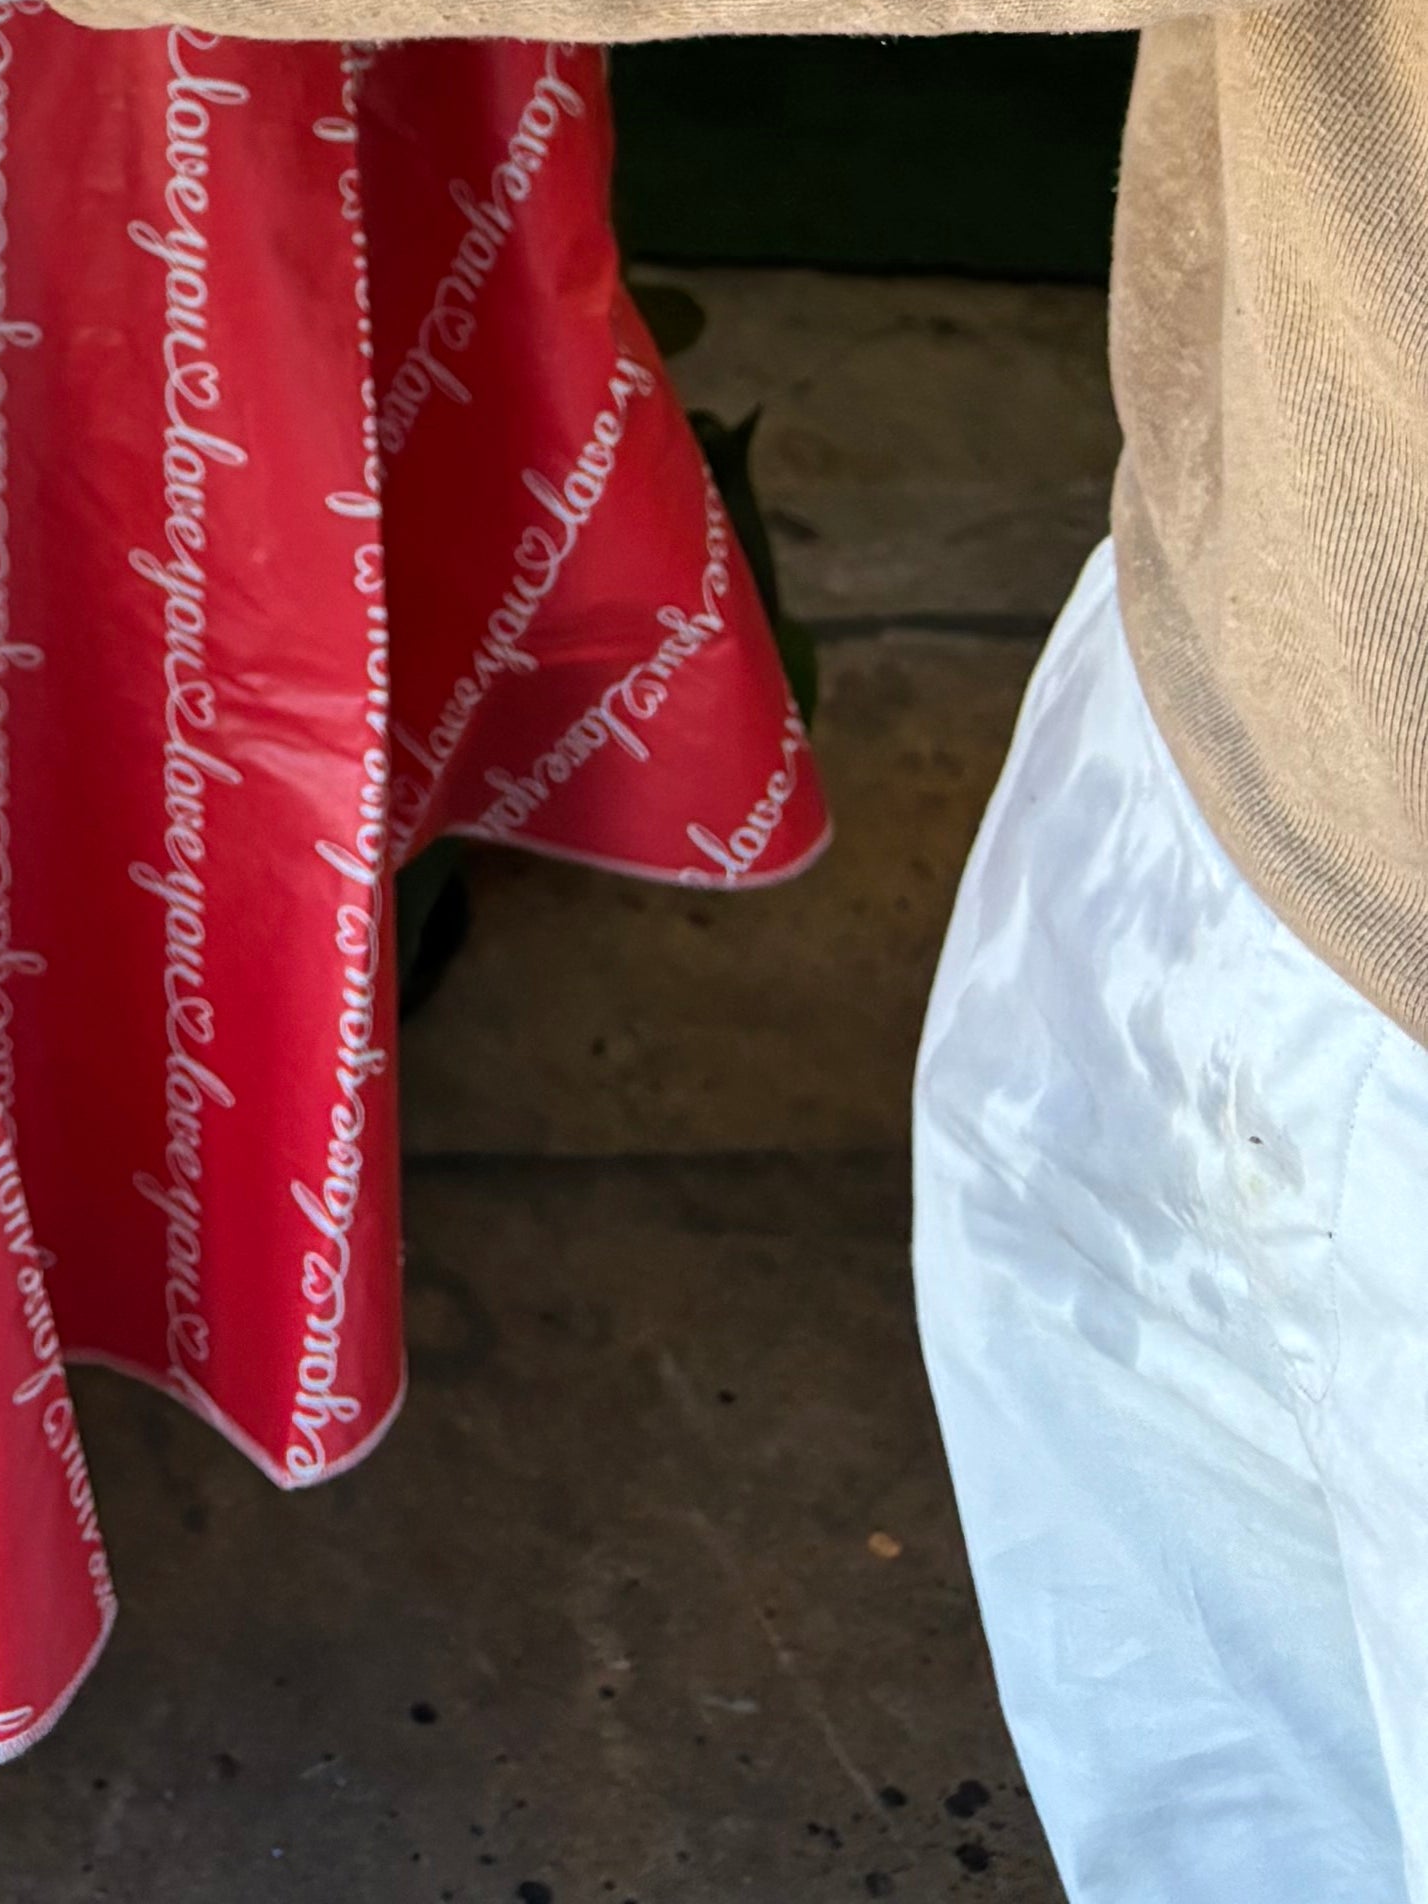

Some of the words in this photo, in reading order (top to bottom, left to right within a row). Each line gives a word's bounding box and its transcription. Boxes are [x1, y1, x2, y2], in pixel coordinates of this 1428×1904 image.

[164, 77, 250, 215] love
[491, 76, 586, 202] love
[126, 219, 208, 352] you
[162, 427, 249, 554] love
[520, 408, 623, 525] love
[127, 547, 206, 672] you
[162, 741, 243, 867] love
[127, 859, 206, 988] you
[164, 1049, 237, 1186] love
[290, 1098, 366, 1238] love
